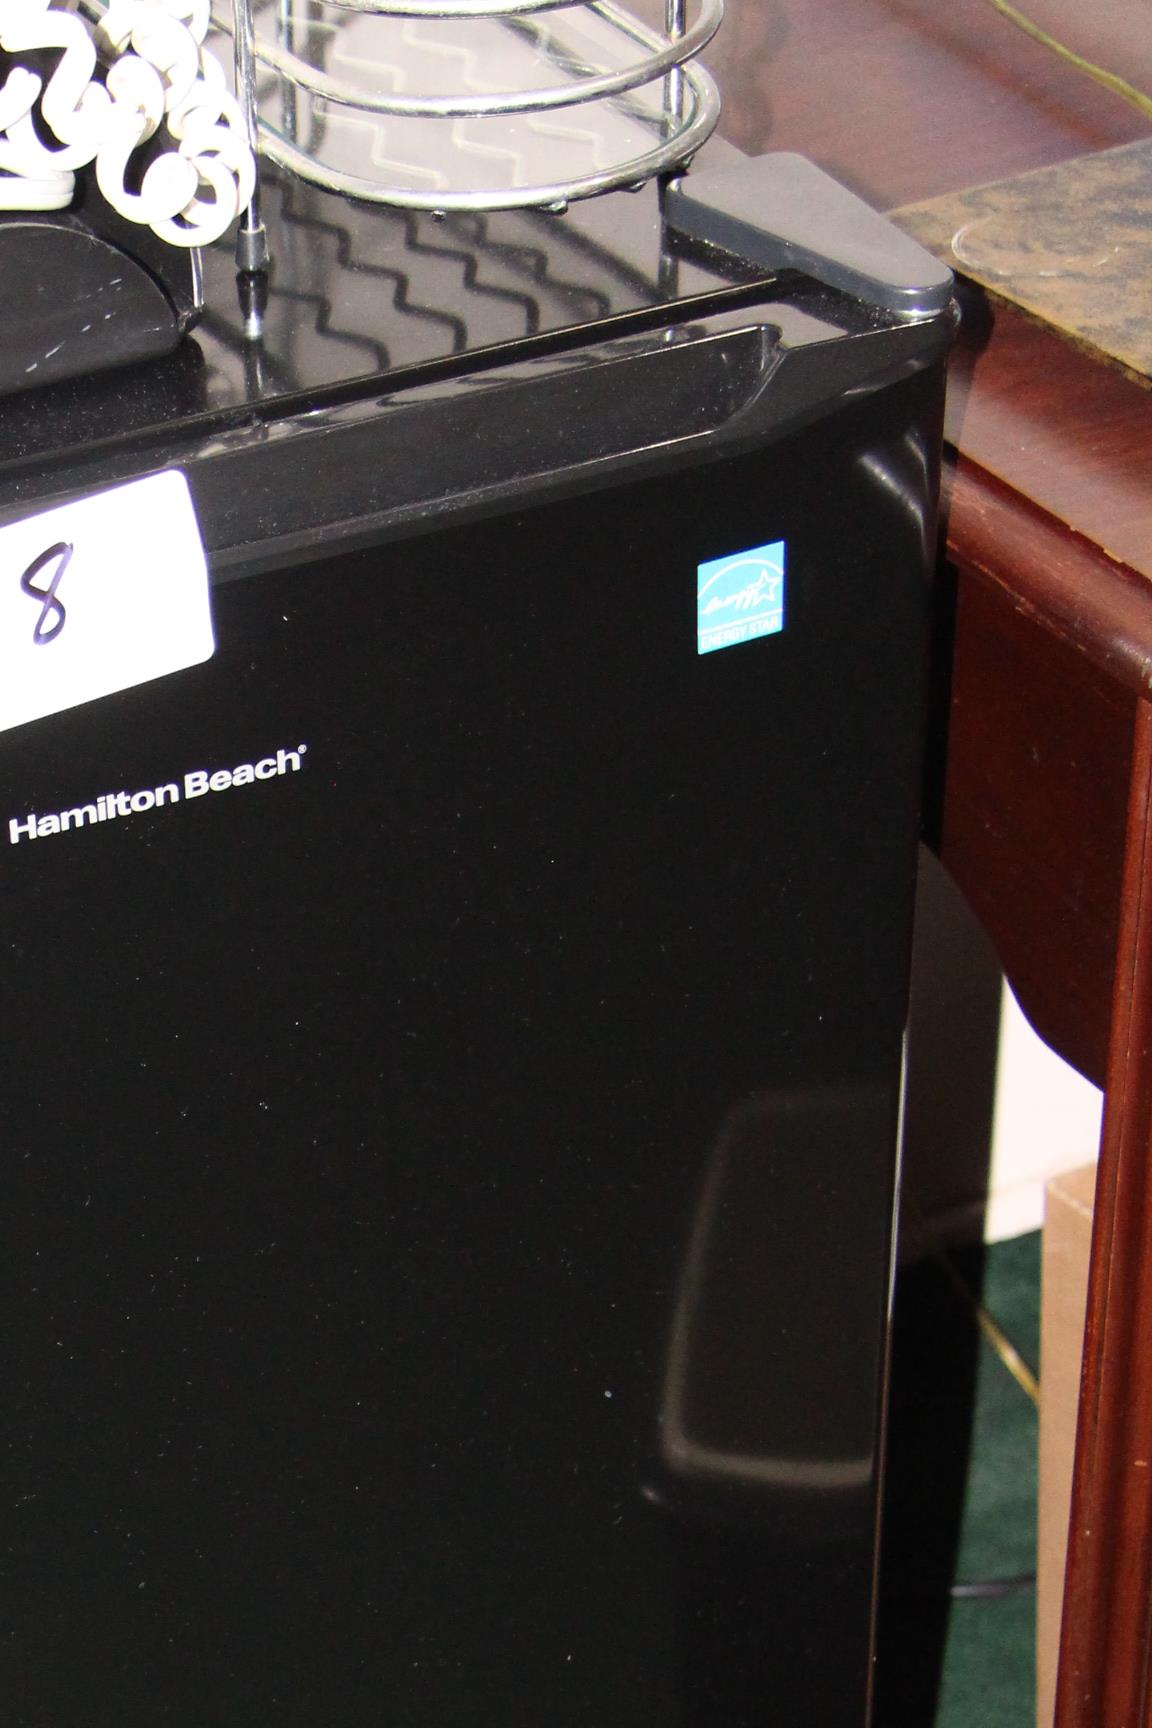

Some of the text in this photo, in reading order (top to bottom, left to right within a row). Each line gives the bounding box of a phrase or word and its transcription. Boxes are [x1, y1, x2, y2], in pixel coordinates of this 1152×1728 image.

[700, 615, 779, 650] ENERGY STAR
[9, 782, 180, 845] Hamilton
